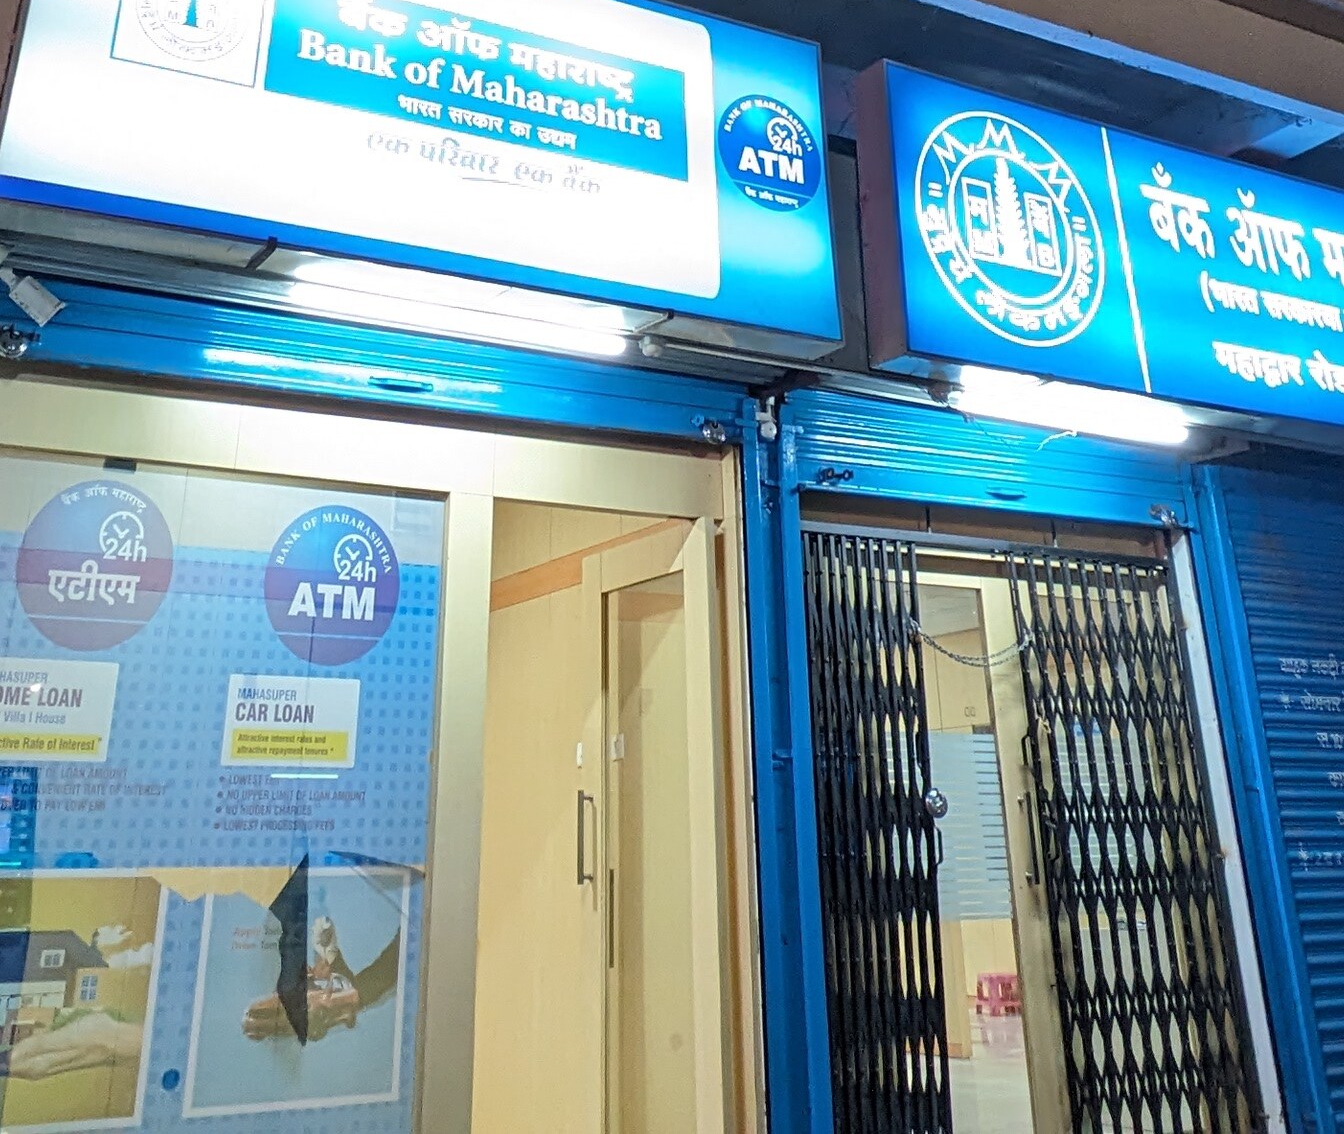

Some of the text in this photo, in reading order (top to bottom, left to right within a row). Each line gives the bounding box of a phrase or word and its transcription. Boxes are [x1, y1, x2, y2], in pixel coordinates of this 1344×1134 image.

[417, 18, 502, 61] ऑफ
[509, 42, 635, 104] महाराष्ट्र
[297, 29, 663, 141] Bank of Maharashtra
[397, 95, 577, 150] भारत सरकार का उद्यम
[724, 107, 741, 132] BANK
[773, 135, 803, 157] 24h
[738, 146, 804, 184] ATM
[1226, 187, 1311, 281] ऑफ
[103, 538, 148, 562] 24h
[276, 513, 392, 574] BANK OF MAHARASHTRA
[48, 560, 140, 605] एटीएम
[338, 559, 377, 583] 24h
[287, 582, 376, 621] ATM
[37, 685, 83, 708] LOAN
[237, 688, 297, 701] MAHASUPER
[4, 710, 26, 723] Villa
[34, 712, 66, 725] House
[236, 703, 315, 723] CAR LOAN
[23, 737, 44, 750] Rate
[47, 738, 57, 750] of
[59, 738, 95, 751] Interest
[237, 733, 269, 742] Attractive
[314, 735, 326, 744] and
[237, 745, 268, 754] attractive
